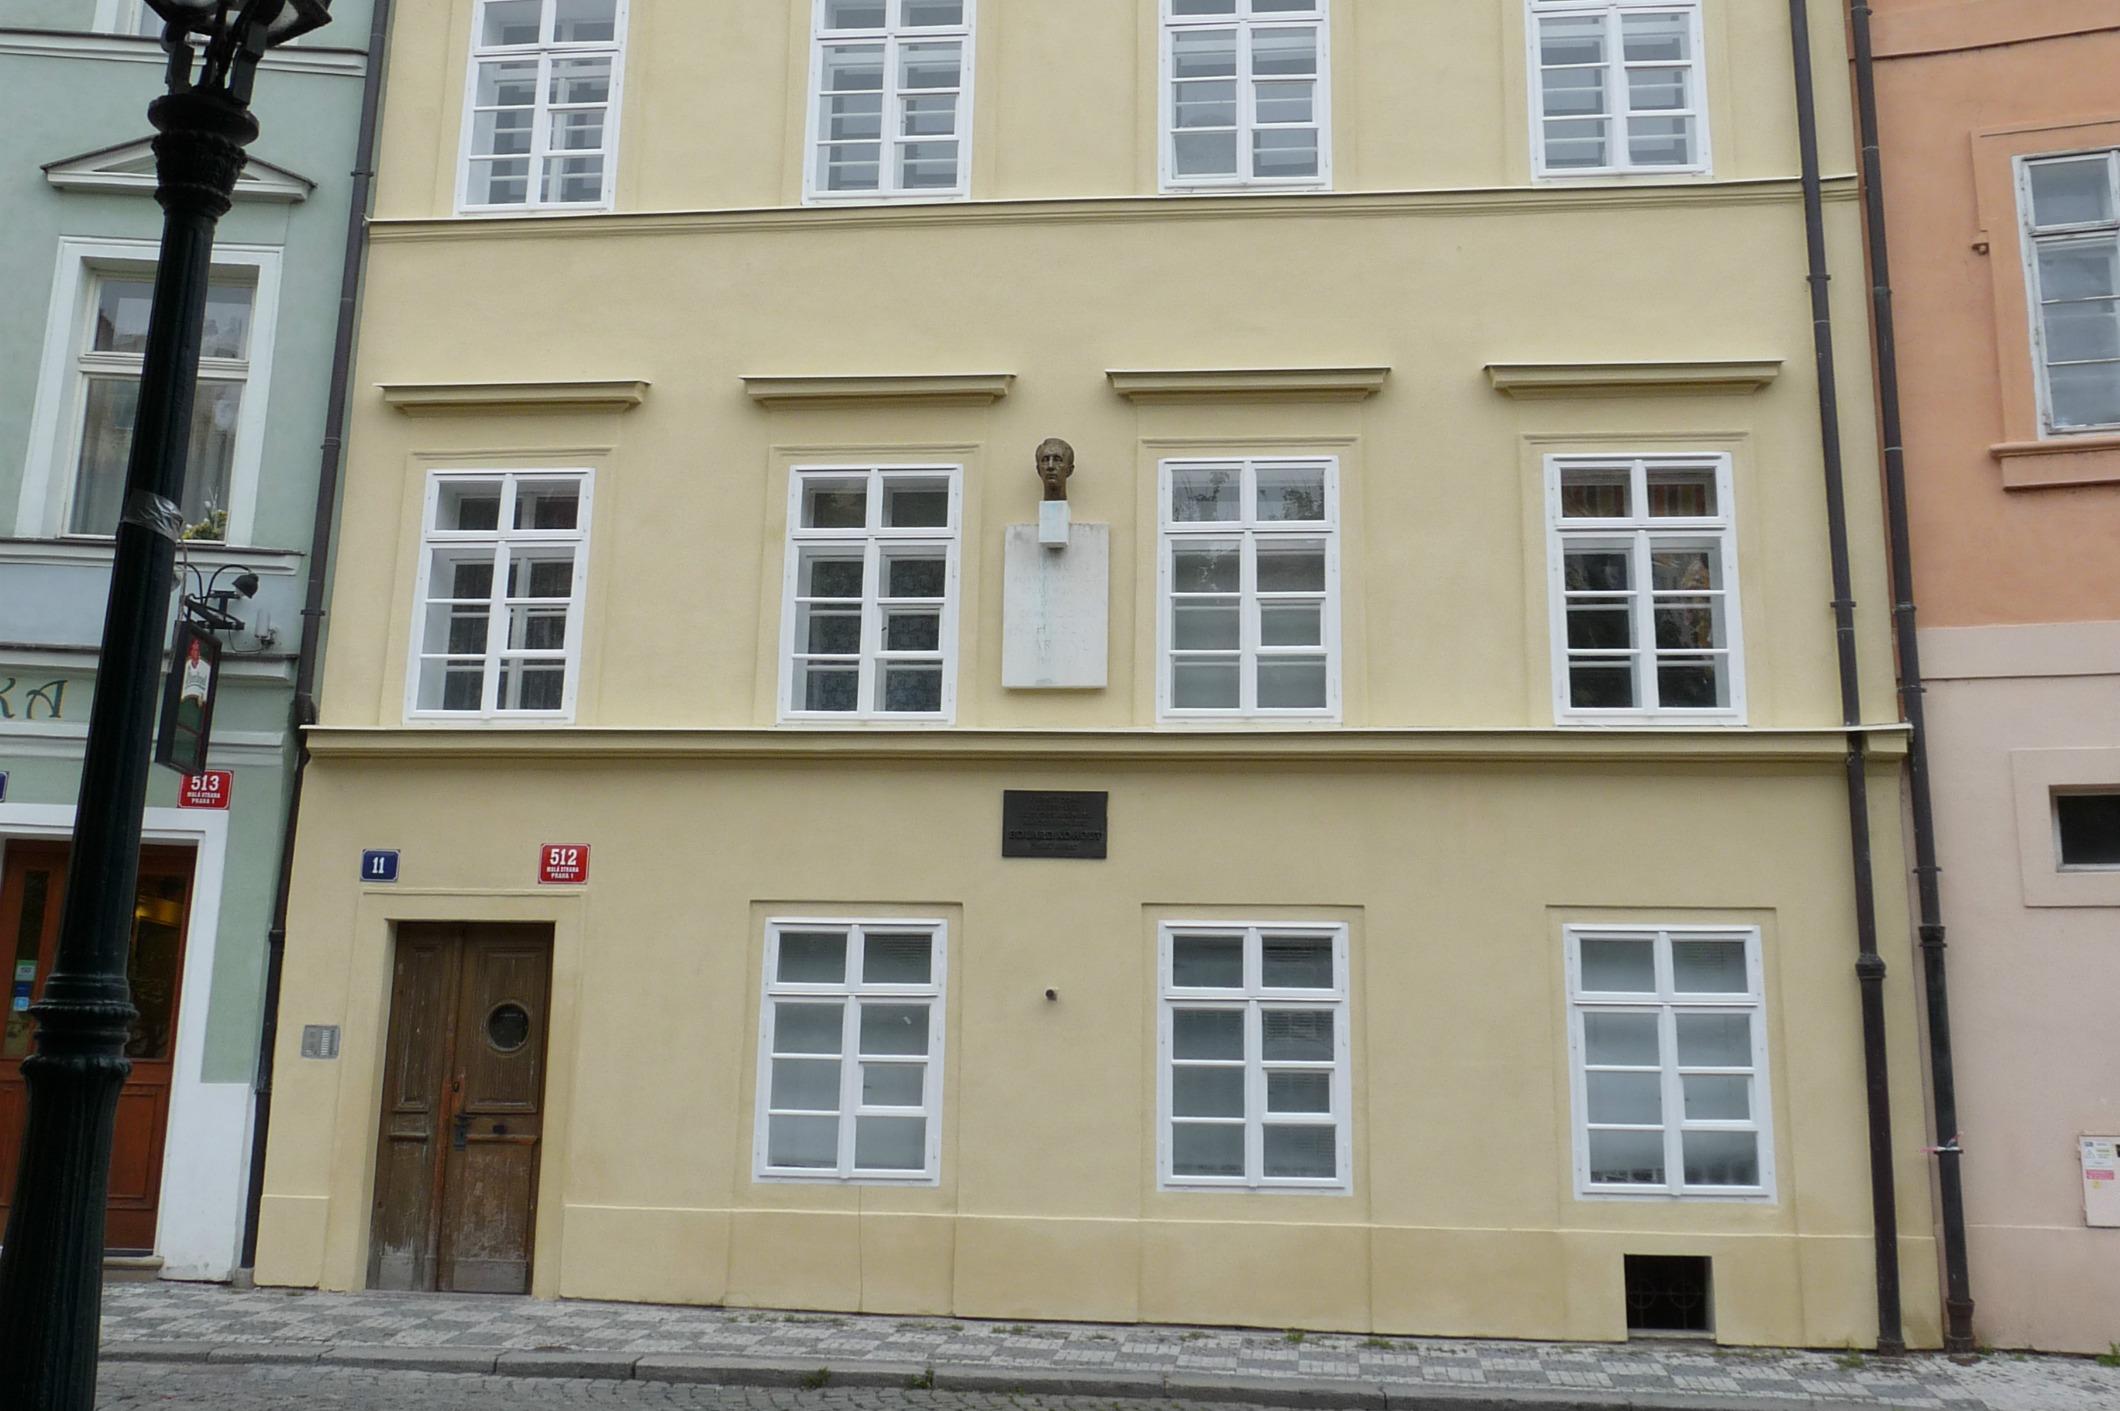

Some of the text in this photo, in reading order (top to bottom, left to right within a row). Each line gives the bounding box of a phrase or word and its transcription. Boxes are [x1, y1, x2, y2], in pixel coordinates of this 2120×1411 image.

[191, 775, 219, 791] 513
[550, 848, 577, 865] 512
[372, 857, 385, 873] 11
